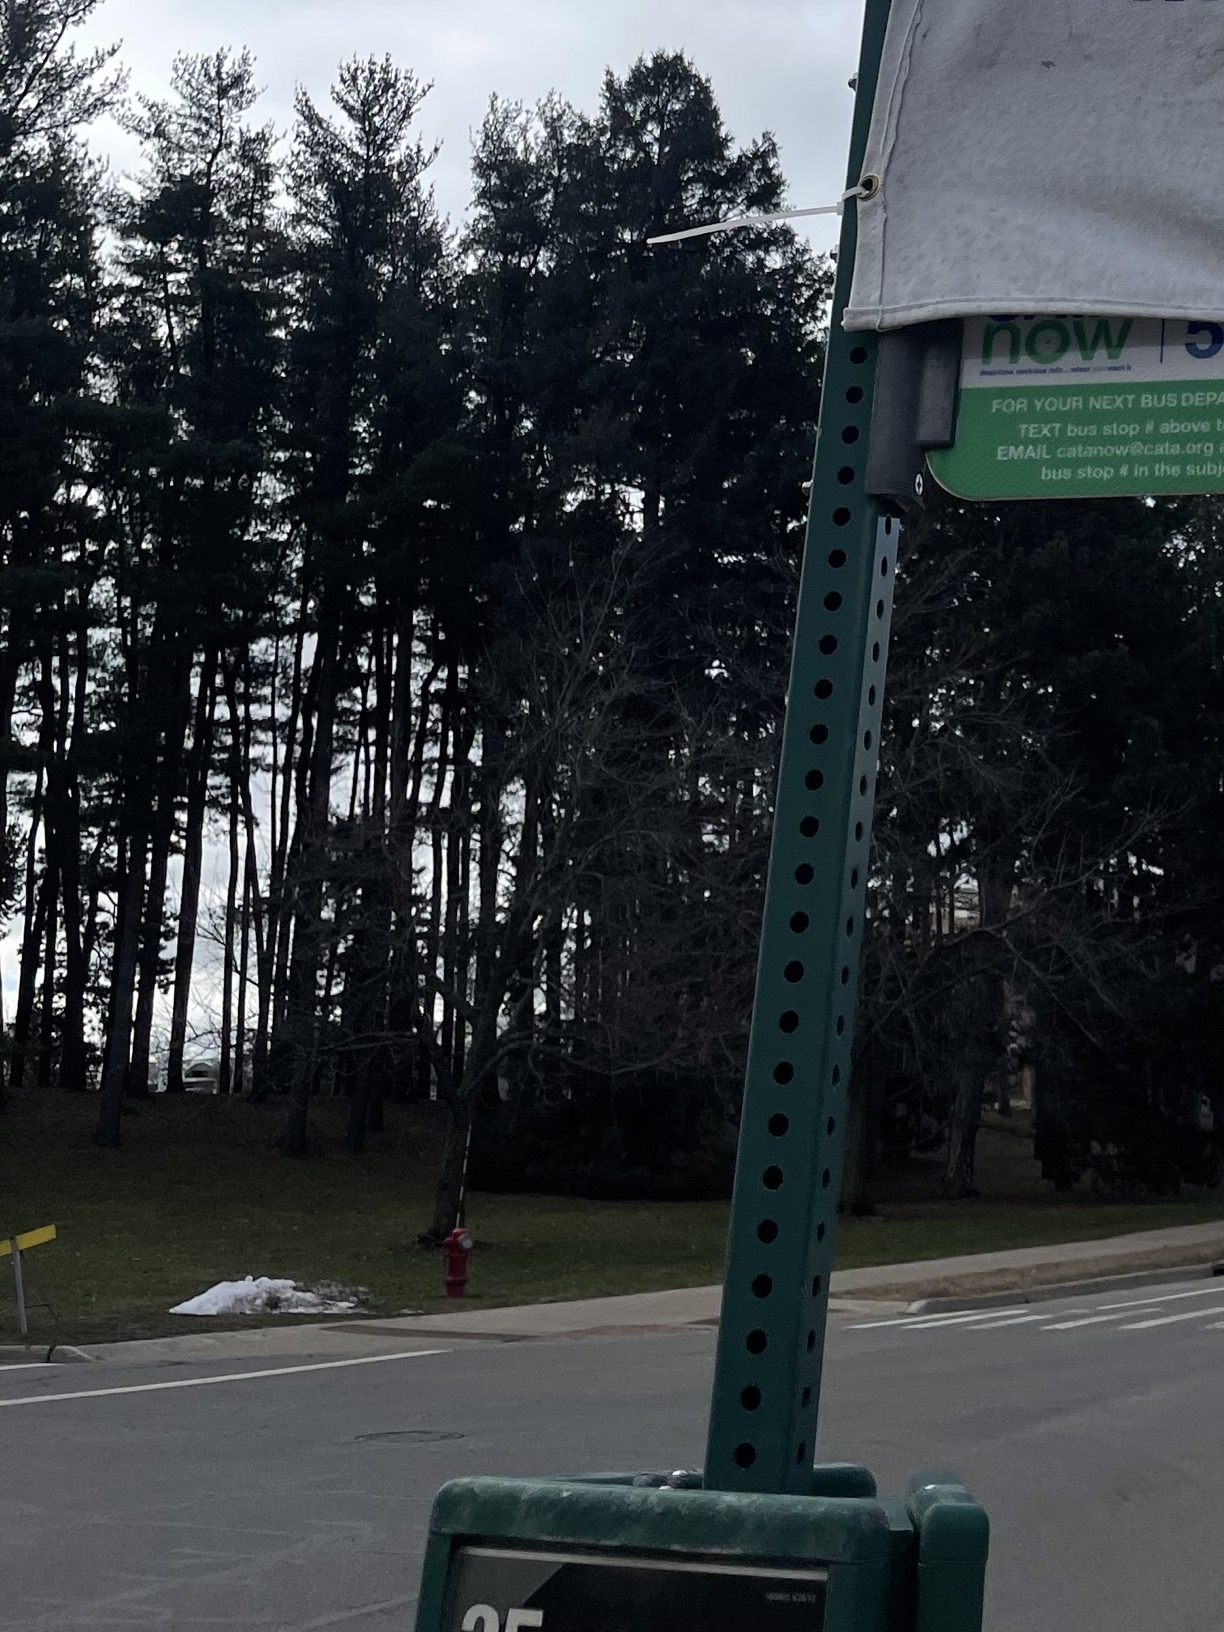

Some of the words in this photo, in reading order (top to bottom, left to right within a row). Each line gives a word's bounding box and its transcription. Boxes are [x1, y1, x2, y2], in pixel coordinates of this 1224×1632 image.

[981, 319, 1135, 365] now
[991, 398, 1028, 414] FOR
[1034, 396, 1084, 412] YOUR
[1088, 394, 1136, 411] NEXT
[1140, 392, 1178, 409] BUS
[1018, 423, 1062, 439] TEXT
[1067, 422, 1098, 437] bus
[1102, 421, 1140, 439] stop
[1145, 419, 1155, 435] #
[1159, 418, 1211, 435] above
[996, 443, 1052, 461] EMAIL
[1056, 439, 1214, 459] catanow@cata.org
[1040, 465, 1072, 480] bus
[1077, 464, 1114, 481] stop
[1134, 463, 1149, 478] in
[1154, 461, 1181, 477] the
